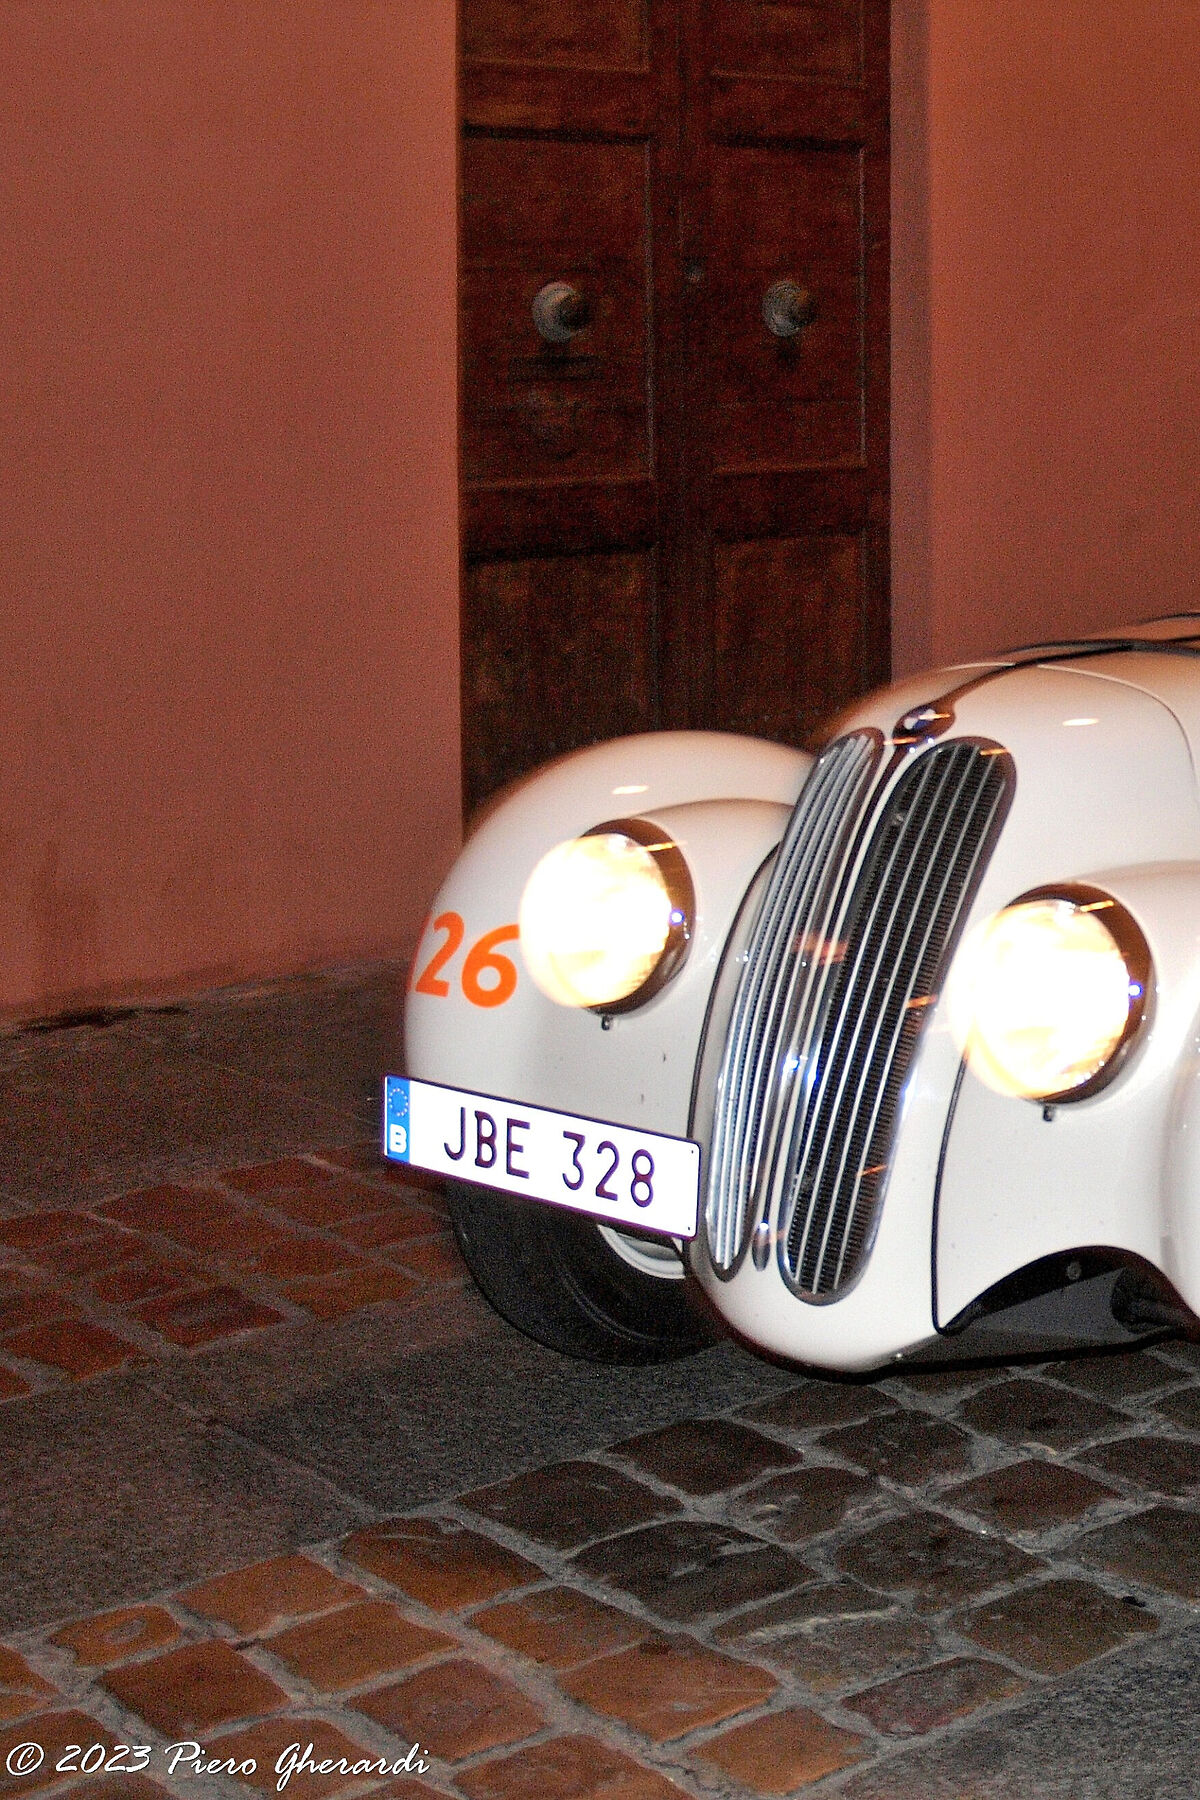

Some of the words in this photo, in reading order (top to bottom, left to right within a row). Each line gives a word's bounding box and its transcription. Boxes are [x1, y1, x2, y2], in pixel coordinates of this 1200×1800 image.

[389, 1124, 407, 1154] B
[444, 1106, 531, 1179] JBE
[562, 1130, 656, 1208] 328
